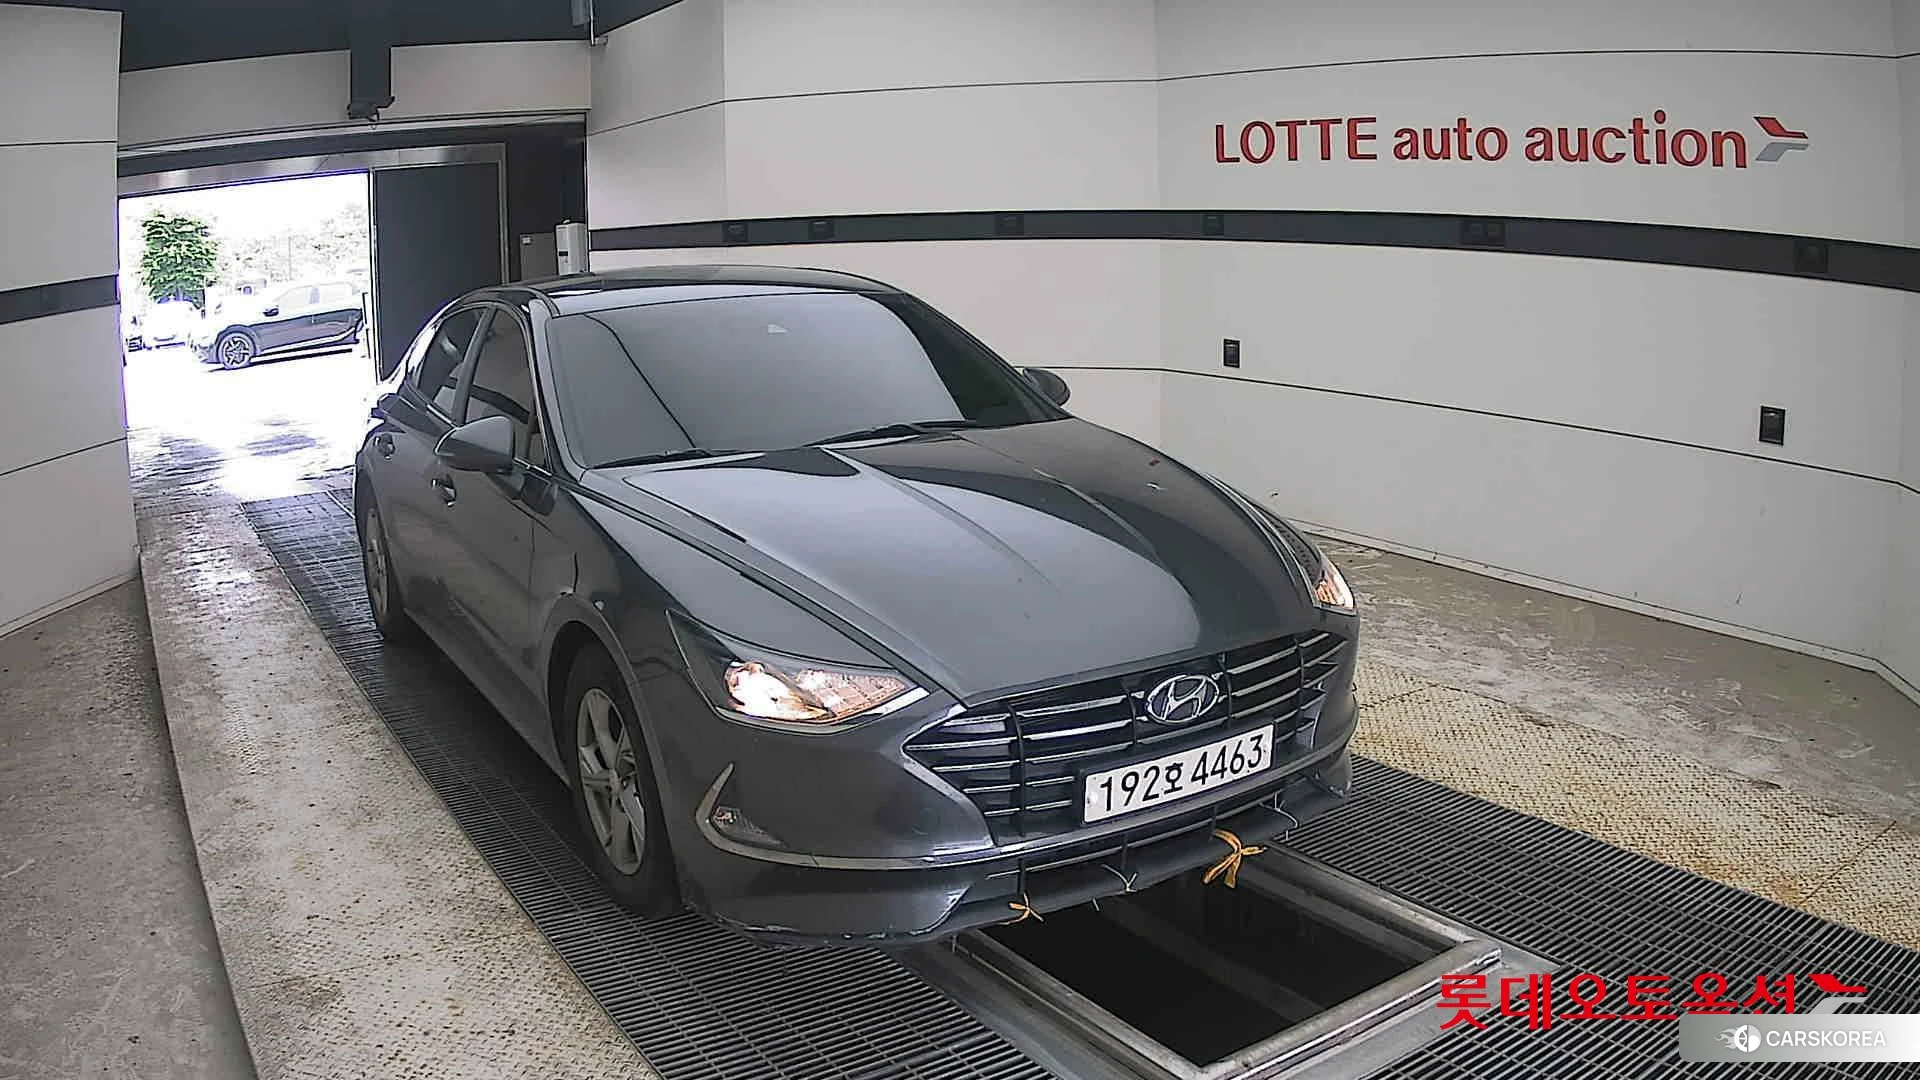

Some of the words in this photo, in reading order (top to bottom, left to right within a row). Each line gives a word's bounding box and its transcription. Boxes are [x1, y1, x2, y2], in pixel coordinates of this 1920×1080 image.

[1214, 116, 1377, 164] LOTTE
[1391, 117, 1508, 163] auto
[1524, 109, 1748, 169] auction
[1099, 760, 1184, 812] 192호
[1190, 733, 1265, 786] 4463
